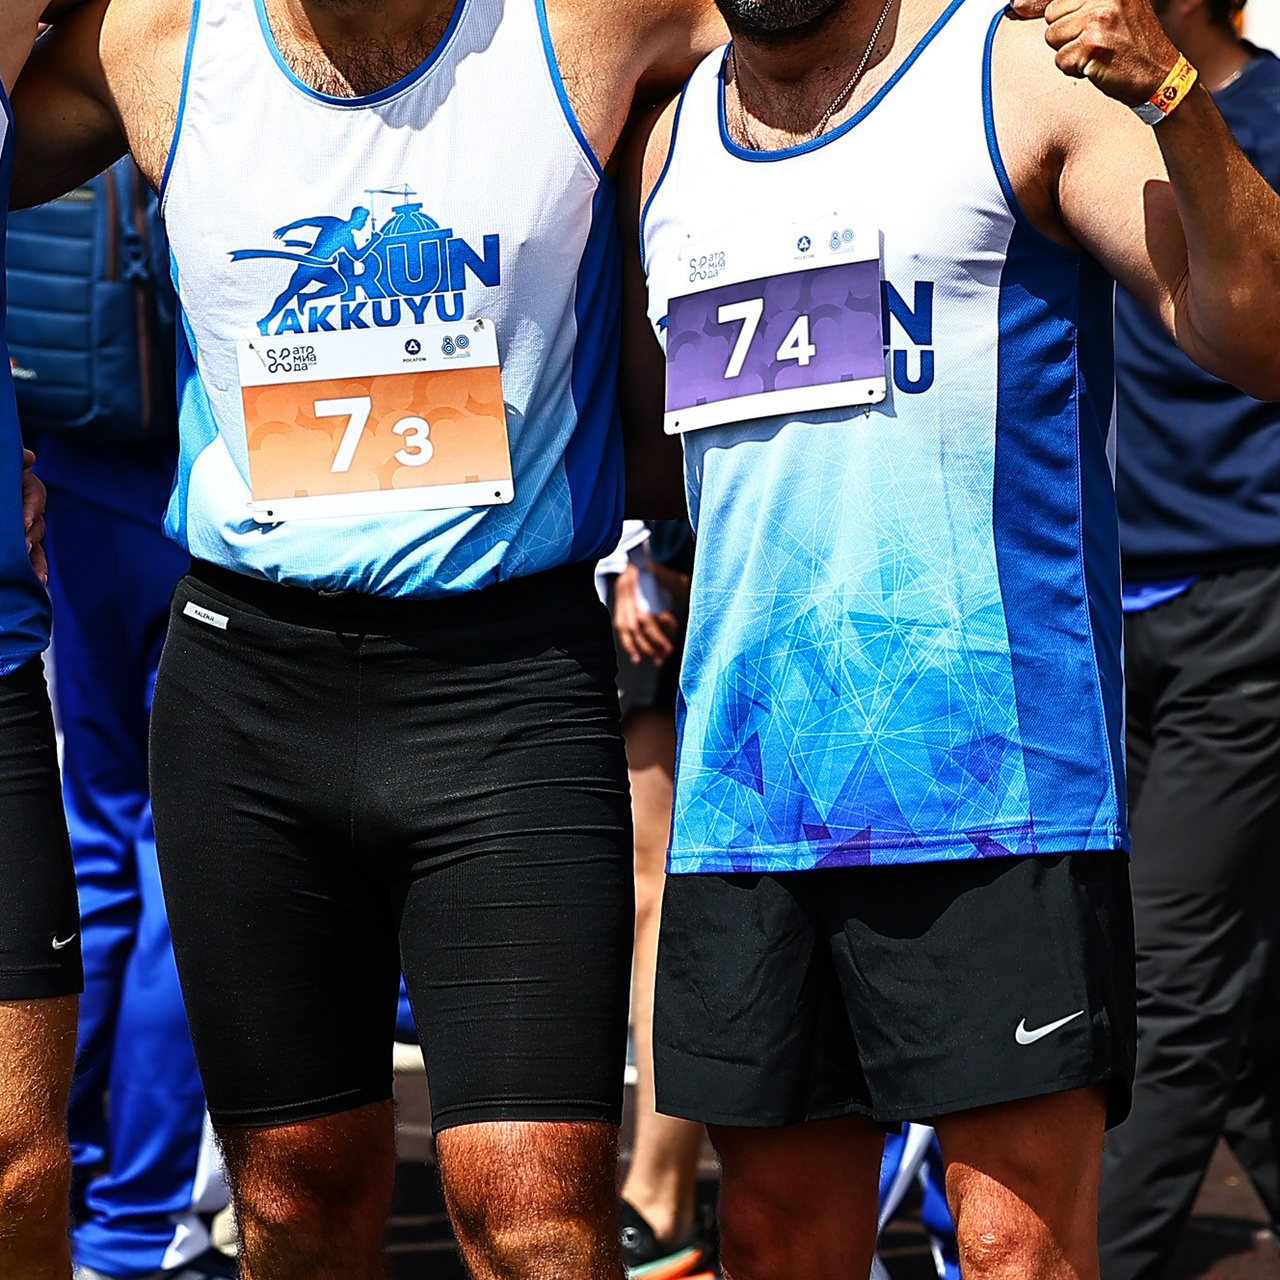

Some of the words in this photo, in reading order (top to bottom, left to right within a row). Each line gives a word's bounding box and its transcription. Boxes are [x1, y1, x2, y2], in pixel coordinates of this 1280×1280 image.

[338, 233, 501, 303] RUN
[275, 292, 464, 336] AKKUYU
[717, 298, 764, 379] 7
[775, 315, 816, 367] 4
[314, 396, 372, 473] 7
[392, 415, 435, 467] 3
